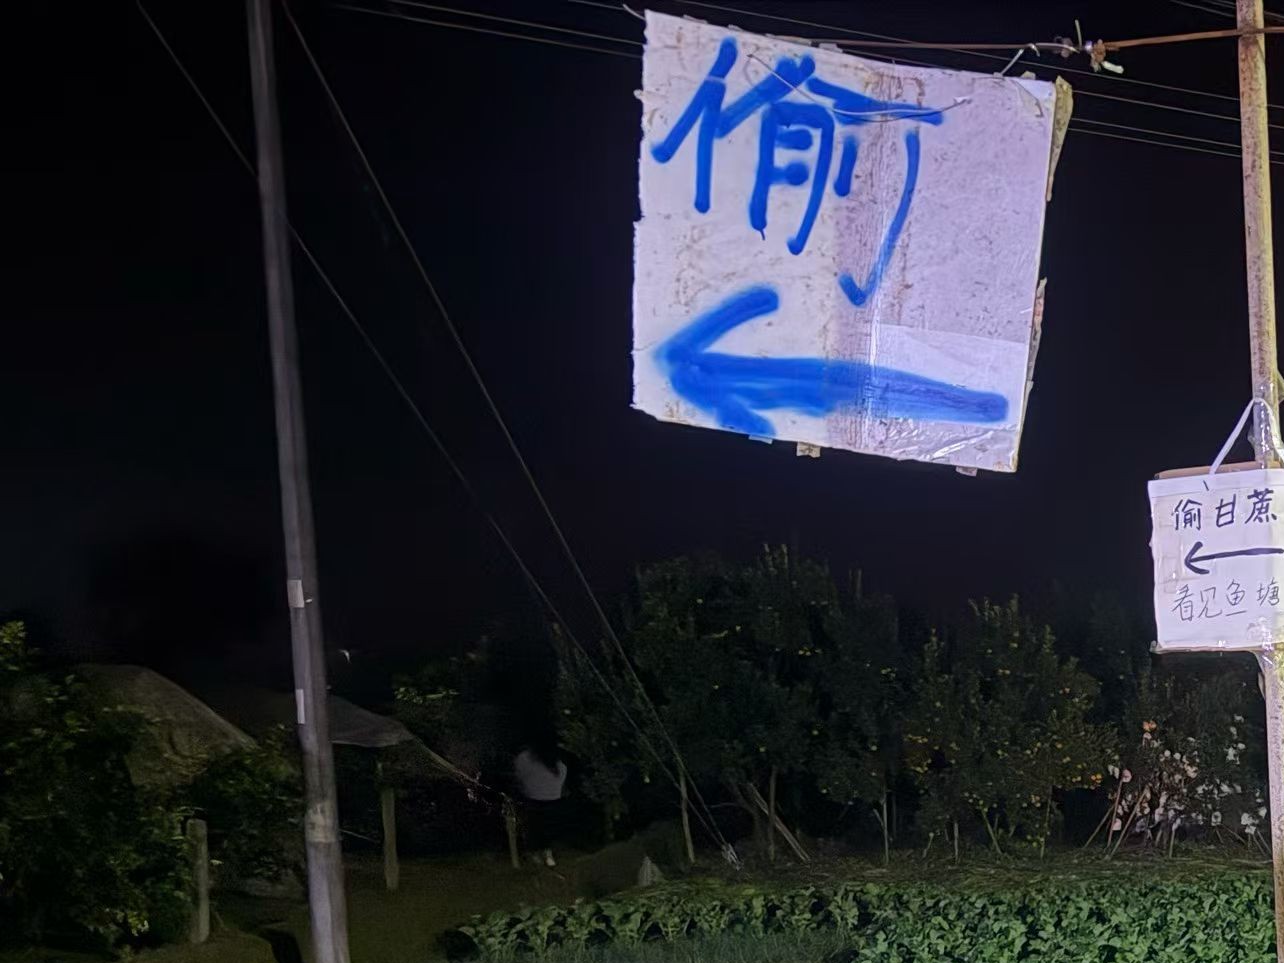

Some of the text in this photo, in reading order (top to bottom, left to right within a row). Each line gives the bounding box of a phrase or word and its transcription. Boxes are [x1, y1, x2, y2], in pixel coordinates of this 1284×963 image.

[651, 36, 944, 306] 偷
[1174, 488, 1278, 530] 偷甘蔗
